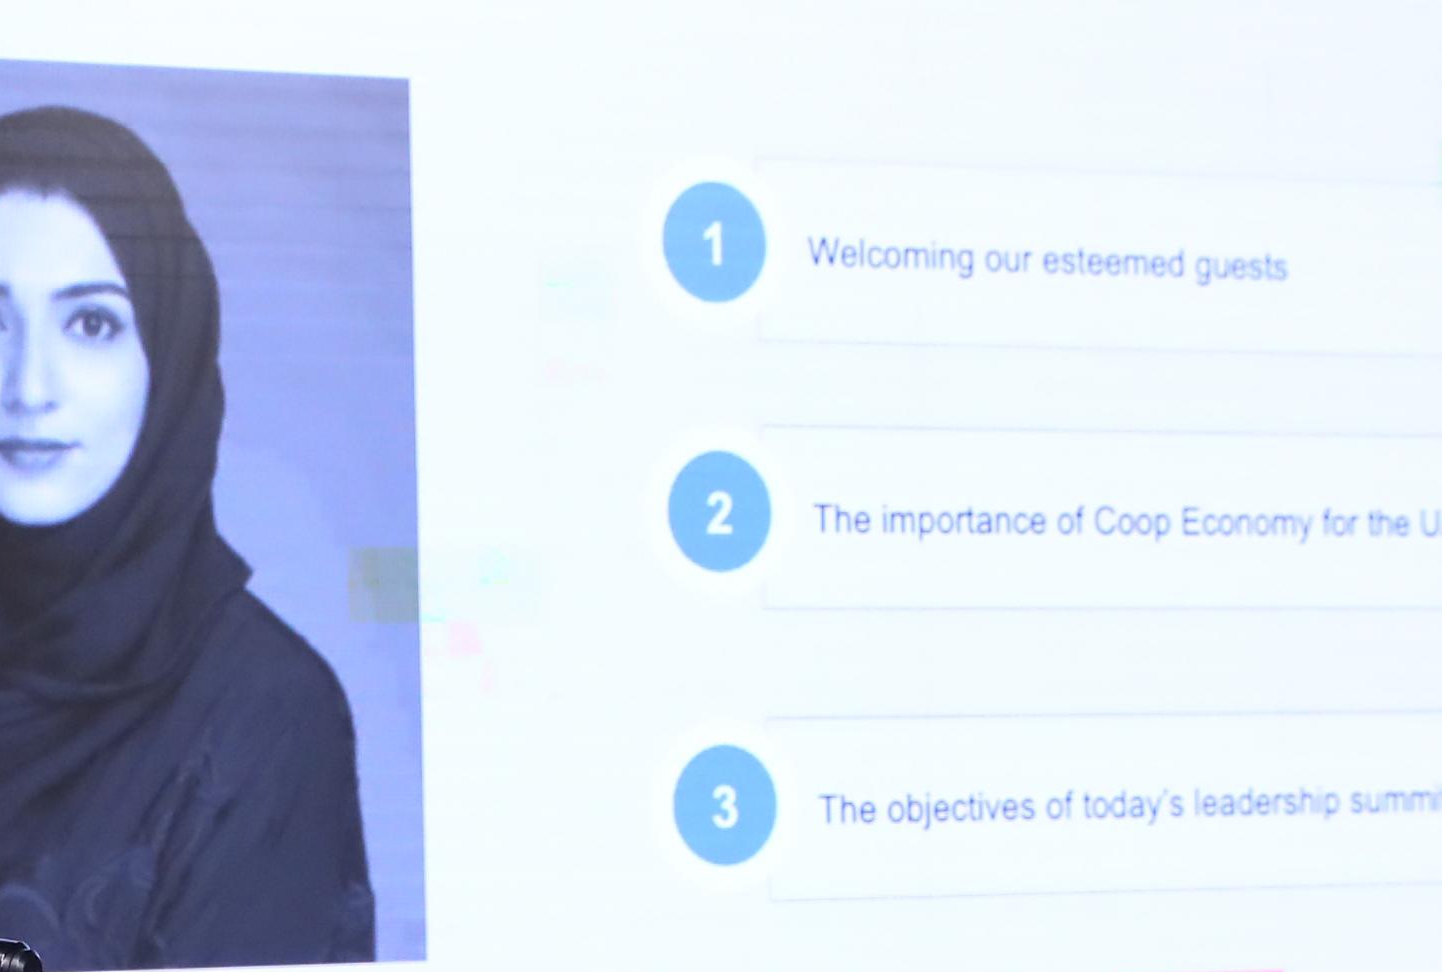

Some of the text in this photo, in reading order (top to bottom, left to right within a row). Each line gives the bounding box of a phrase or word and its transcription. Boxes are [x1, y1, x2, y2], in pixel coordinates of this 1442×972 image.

[703, 221, 723, 266] 1
[808, 236, 1290, 288] Welcoming our esteemed guests
[706, 490, 734, 535] 2
[814, 502, 874, 536] The
[882, 504, 1049, 543] importance
[1057, 504, 1087, 537] of
[1094, 504, 1174, 544] Coop
[1182, 505, 1315, 545] Economy
[1320, 506, 1360, 538] for
[1368, 508, 1413, 539] the
[712, 784, 739, 829] 3
[818, 793, 879, 826] The
[887, 791, 1039, 833] objectives
[1046, 788, 1075, 822] of
[1083, 788, 1186, 827] today's
[1194, 786, 1343, 821] leadership
